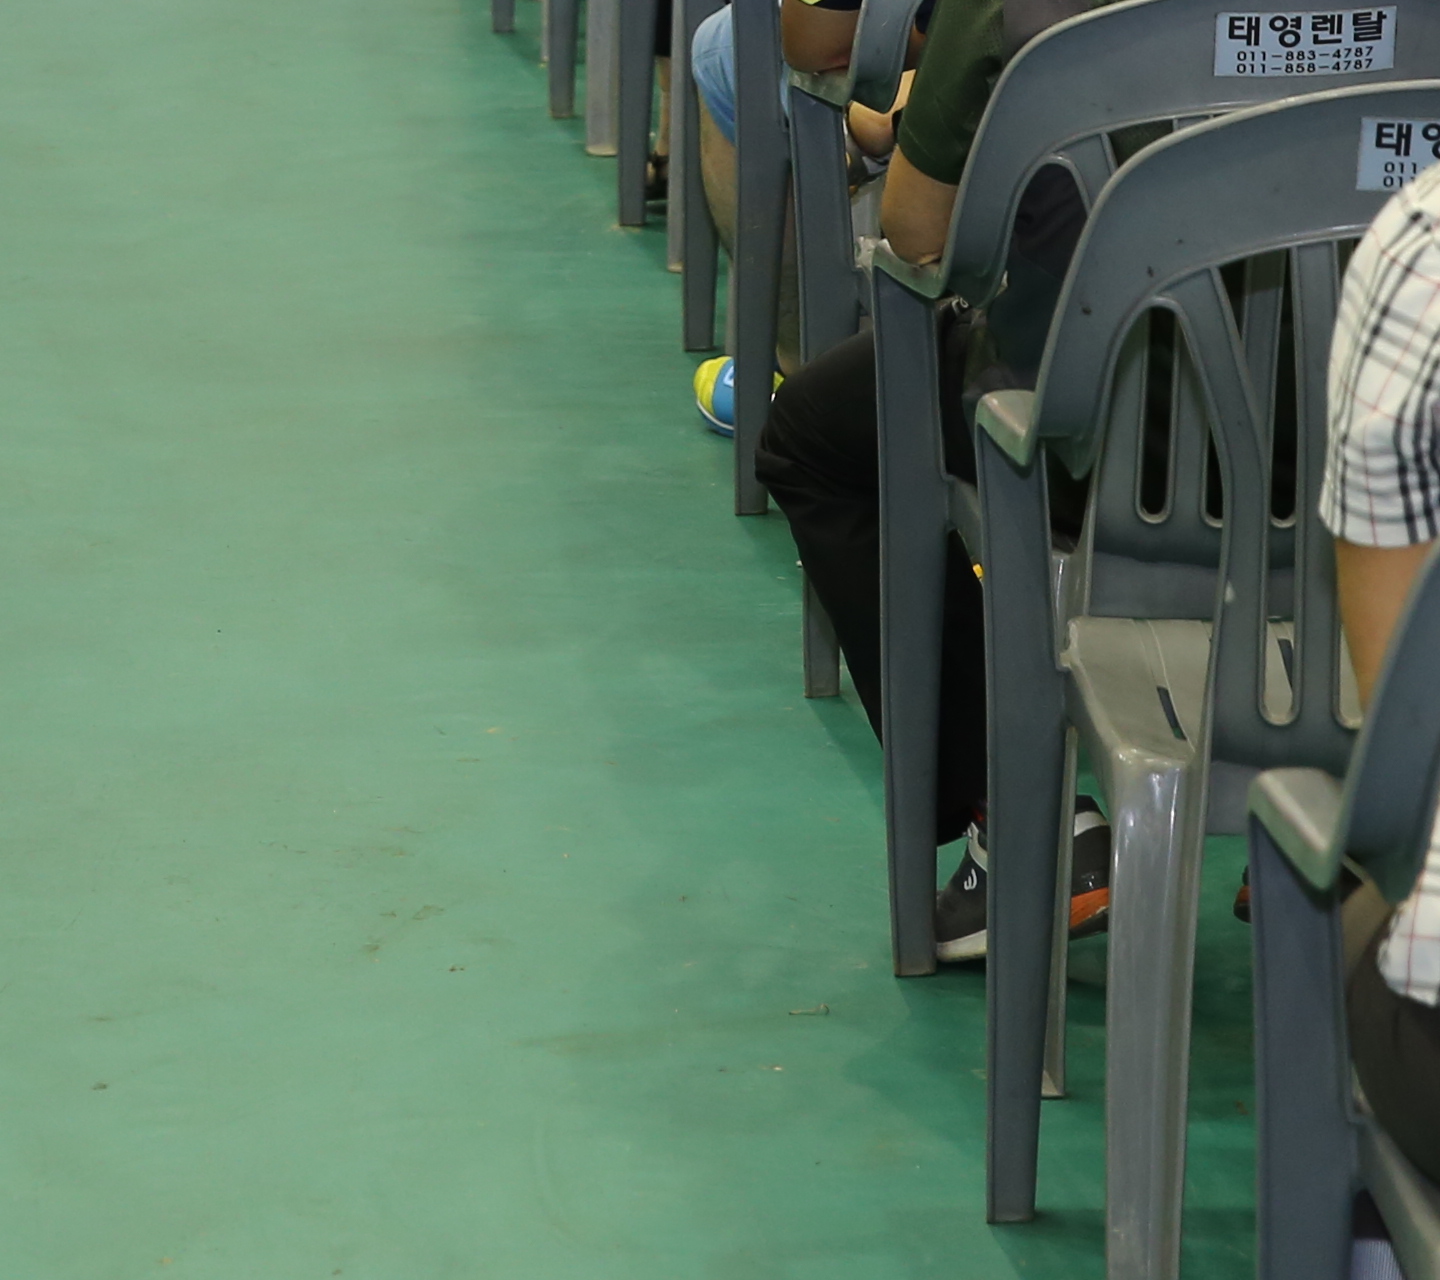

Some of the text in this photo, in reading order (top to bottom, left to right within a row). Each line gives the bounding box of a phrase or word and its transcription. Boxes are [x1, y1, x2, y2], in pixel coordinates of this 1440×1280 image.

[1228, 11, 1388, 49] 태영렌탈
[1236, 46, 1375, 62] 011-883-4787
[1236, 58, 1375, 75] 011-858-4787
